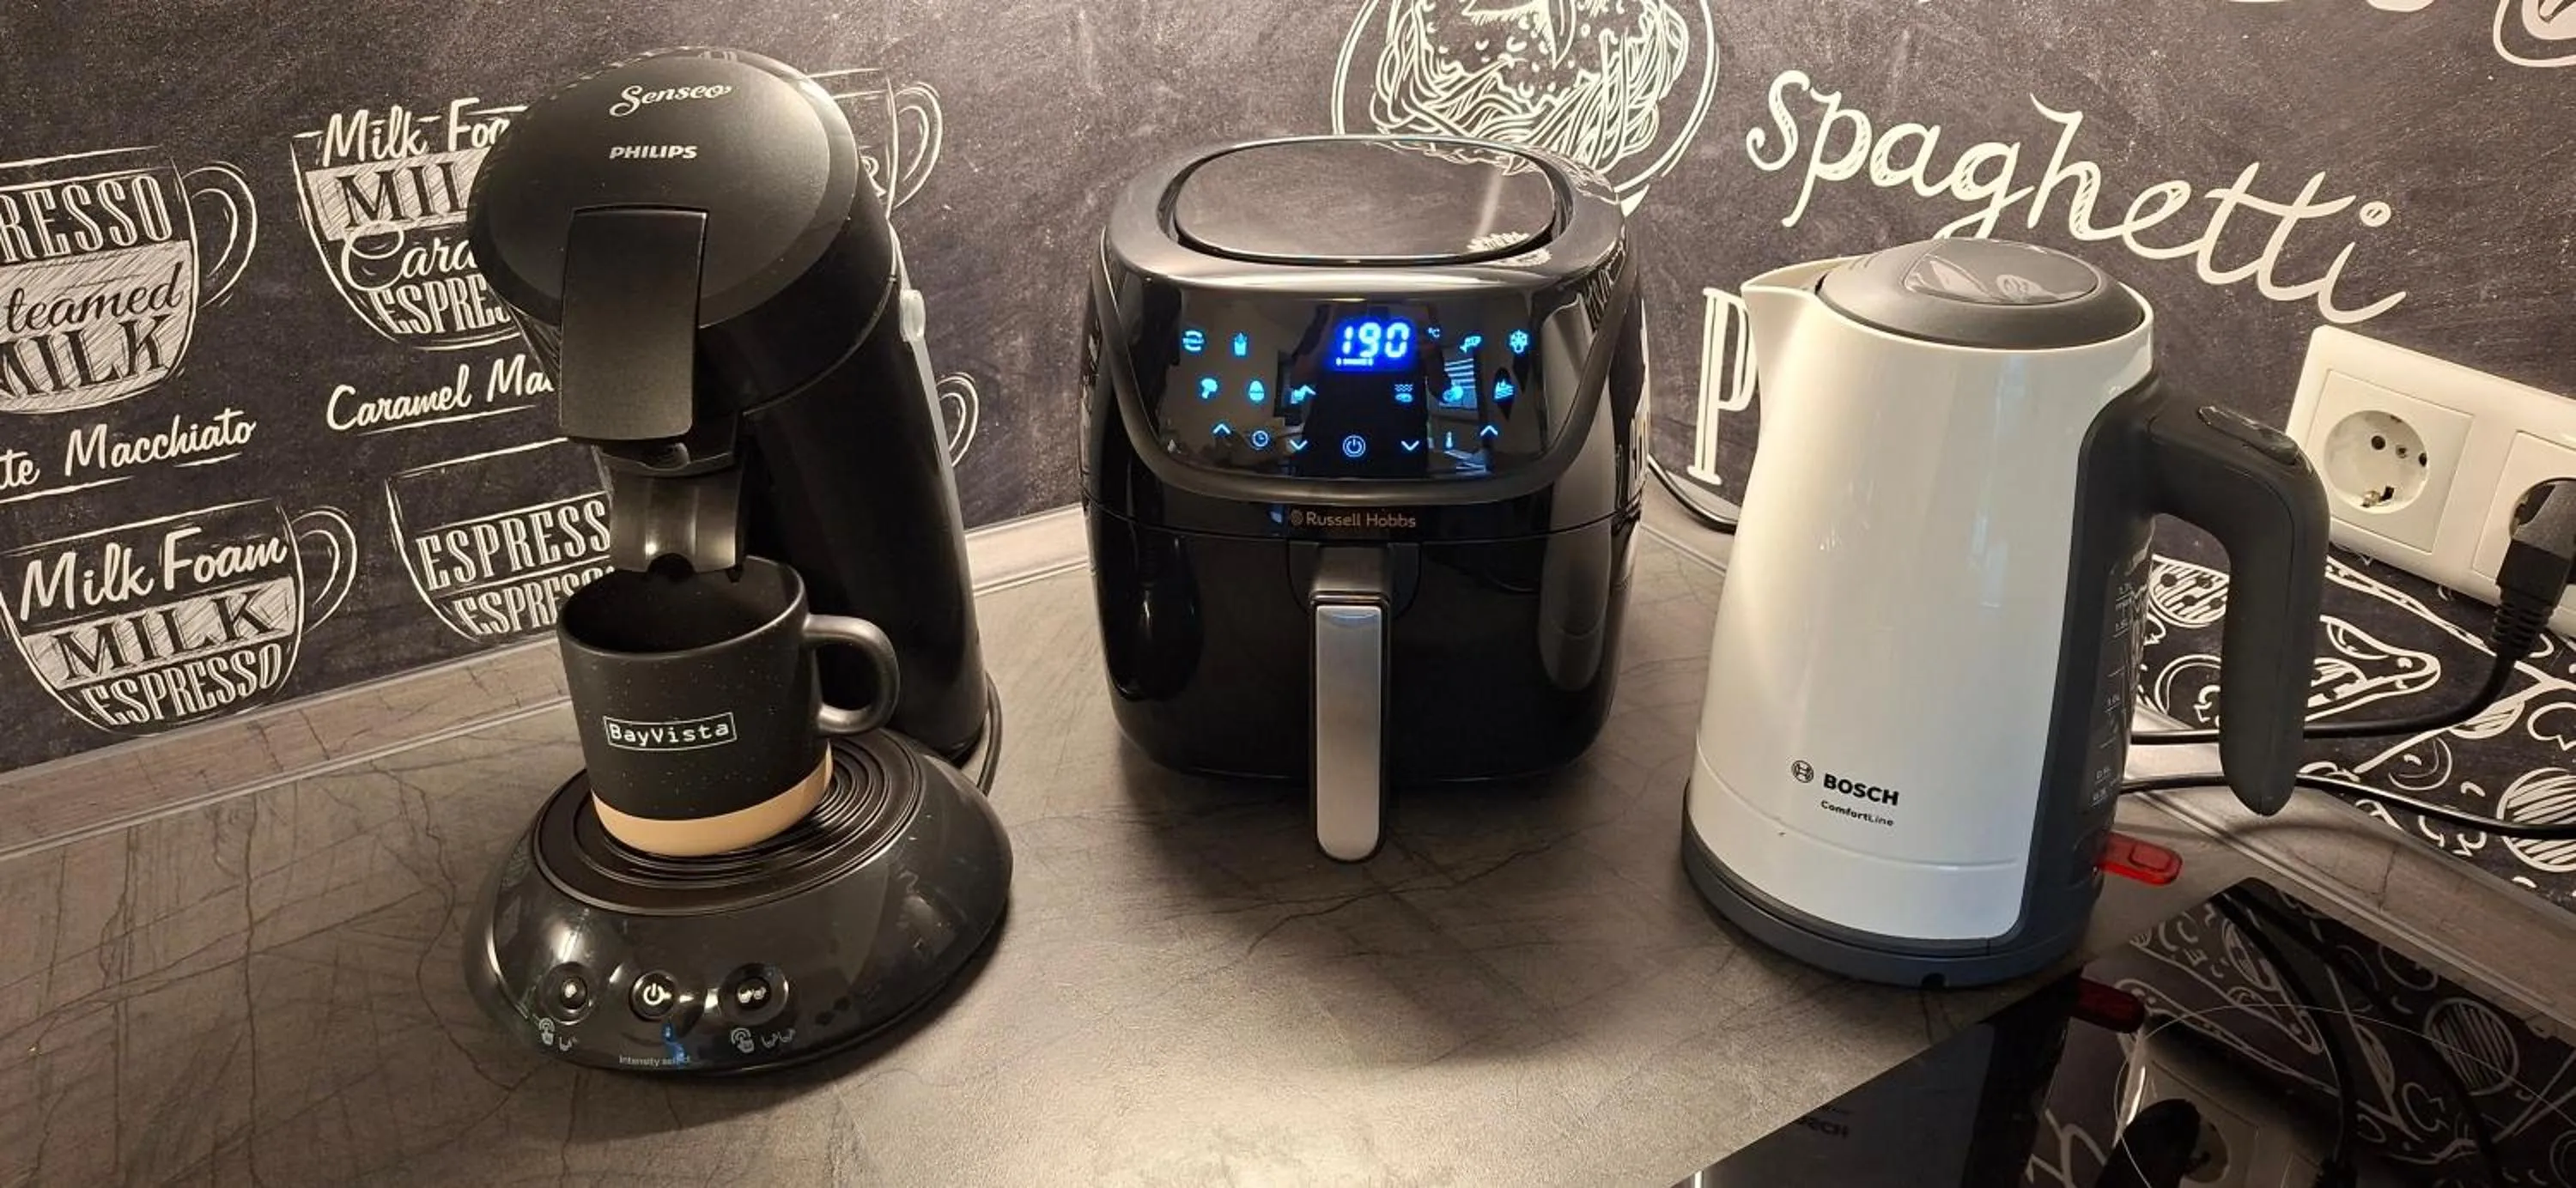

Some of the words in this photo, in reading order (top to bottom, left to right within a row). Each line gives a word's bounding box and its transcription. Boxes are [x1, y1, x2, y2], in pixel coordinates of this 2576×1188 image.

[609, 85, 732, 117] Senseo
[322, 105, 428, 167] Milk
[448, 97, 511, 152] Foa
[609, 145, 698, 160] PHILIPS
[1342, 322, 1411, 358] 190
[327, 364, 472, 430] Caramel
[486, 354, 555, 404] Ma
[64, 406, 257, 476] Macchiato
[1306, 511, 1361, 526] Russell
[1366, 512, 1416, 528] Hobbs
[21, 542, 155, 621] Milk
[164, 526, 288, 591] Foam
[52, 589, 284, 682] MILK
[80, 642, 283, 726] ESPRESSO
[608, 722, 730, 747] BayVista
[1823, 773, 1899, 806] BOSCH
